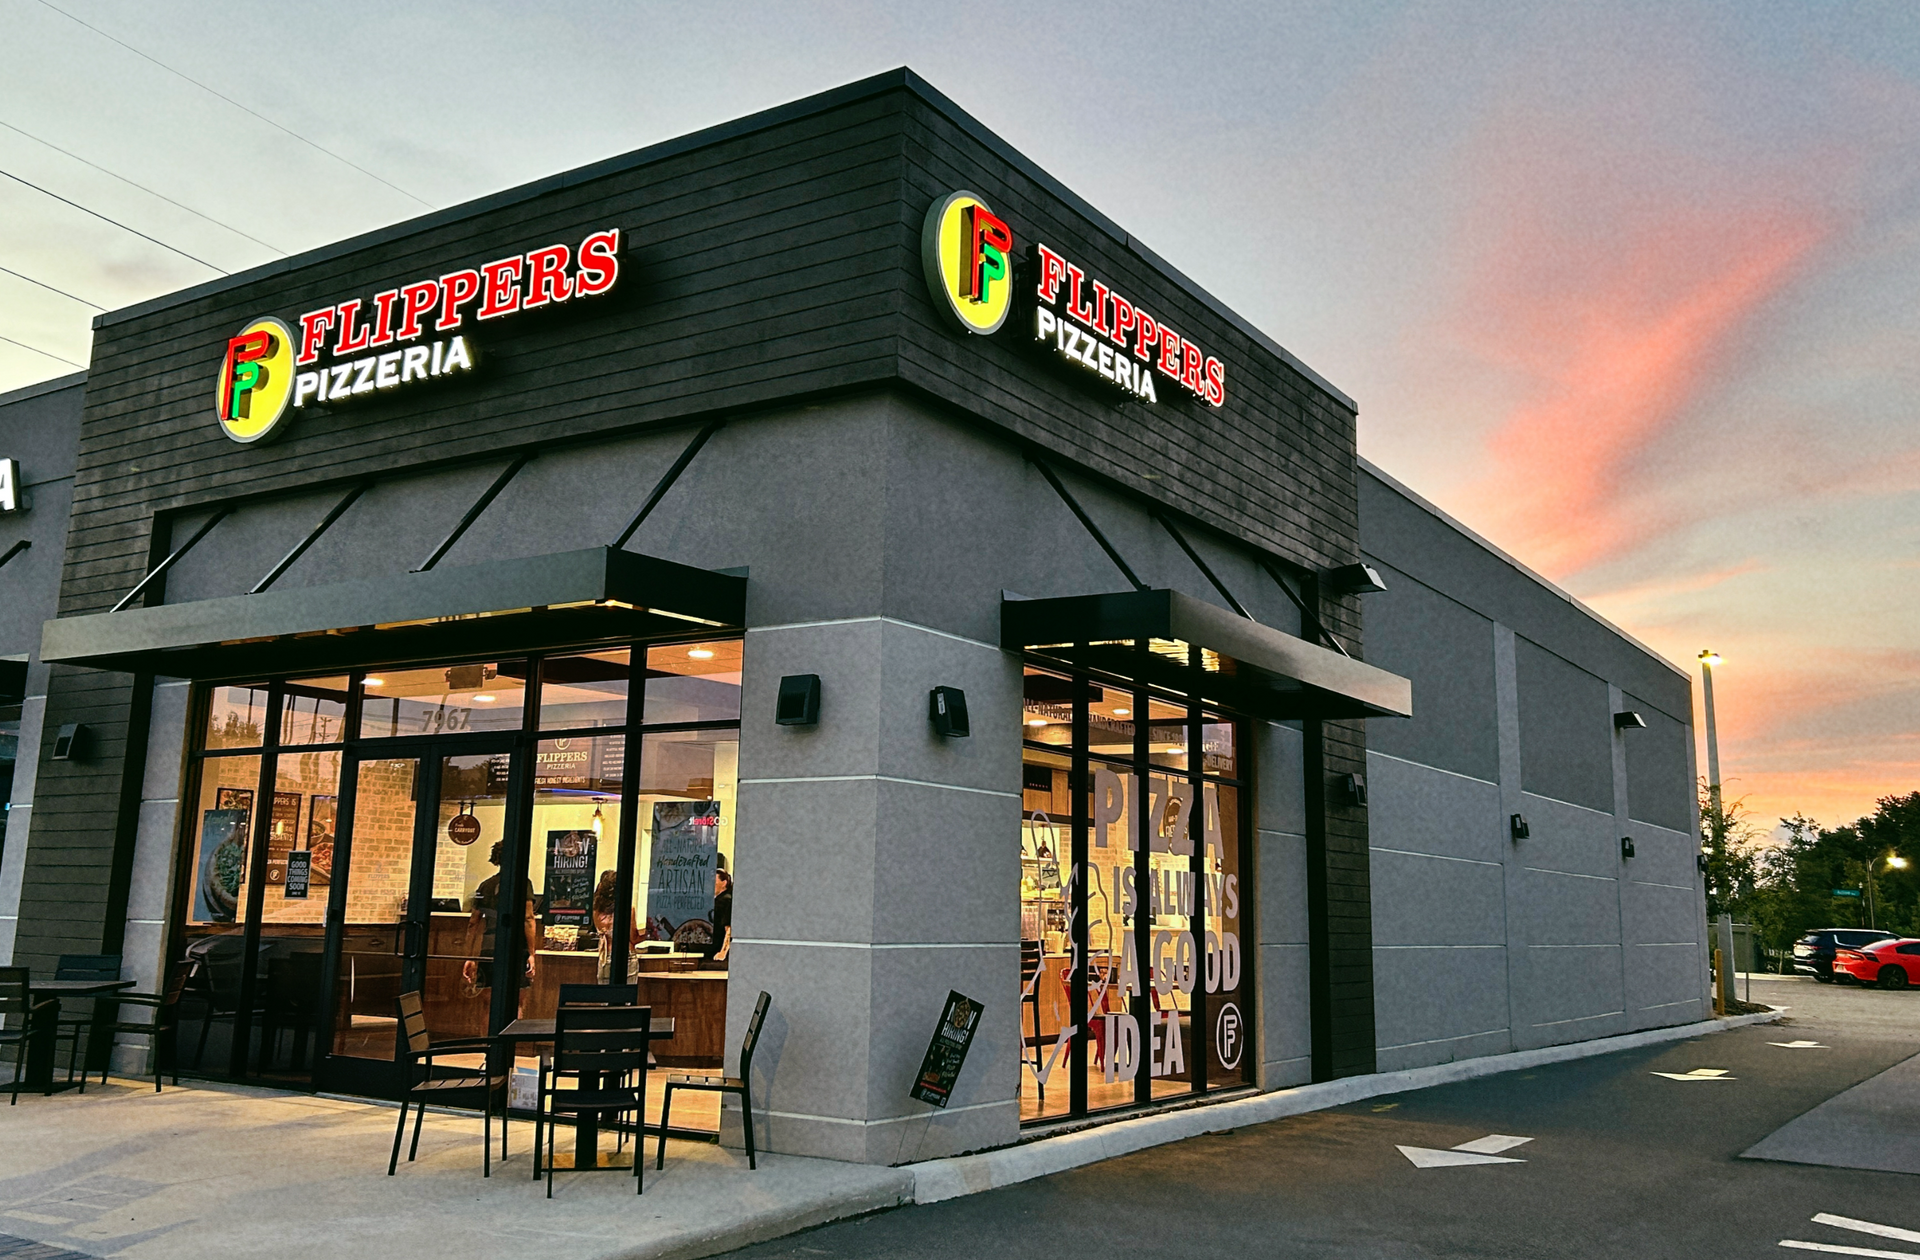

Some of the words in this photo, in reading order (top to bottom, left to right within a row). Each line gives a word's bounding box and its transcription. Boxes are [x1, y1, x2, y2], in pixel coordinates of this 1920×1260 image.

[296, 228, 620, 366] FLIPPERS
[1036, 242, 1225, 407] FLIPPERS
[1036, 305, 1158, 403] PIZZERIA
[293, 335, 472, 408] PIZZERIA
[422, 708, 472, 733] 7967
[536, 751, 588, 764] FLIPPERS
[1095, 768, 1224, 860] PIZZA
[553, 838, 590, 856] NW
[289, 868, 308, 876] THINGS
[291, 861, 307, 869] GOOD
[553, 856, 589, 868] HIRING!
[656, 854, 711, 869] Handcrafted
[289, 882, 305, 890] SOON
[658, 869, 706, 895] ARTISAN
[1113, 866, 1138, 916] IS
[1149, 868, 1239, 919] ALWAYS
[1117, 931, 1142, 997] A
[1153, 930, 1241, 996] GOOD
[940, 1021, 970, 1045] HIRING!
[1104, 1011, 1185, 1084] IDEA
